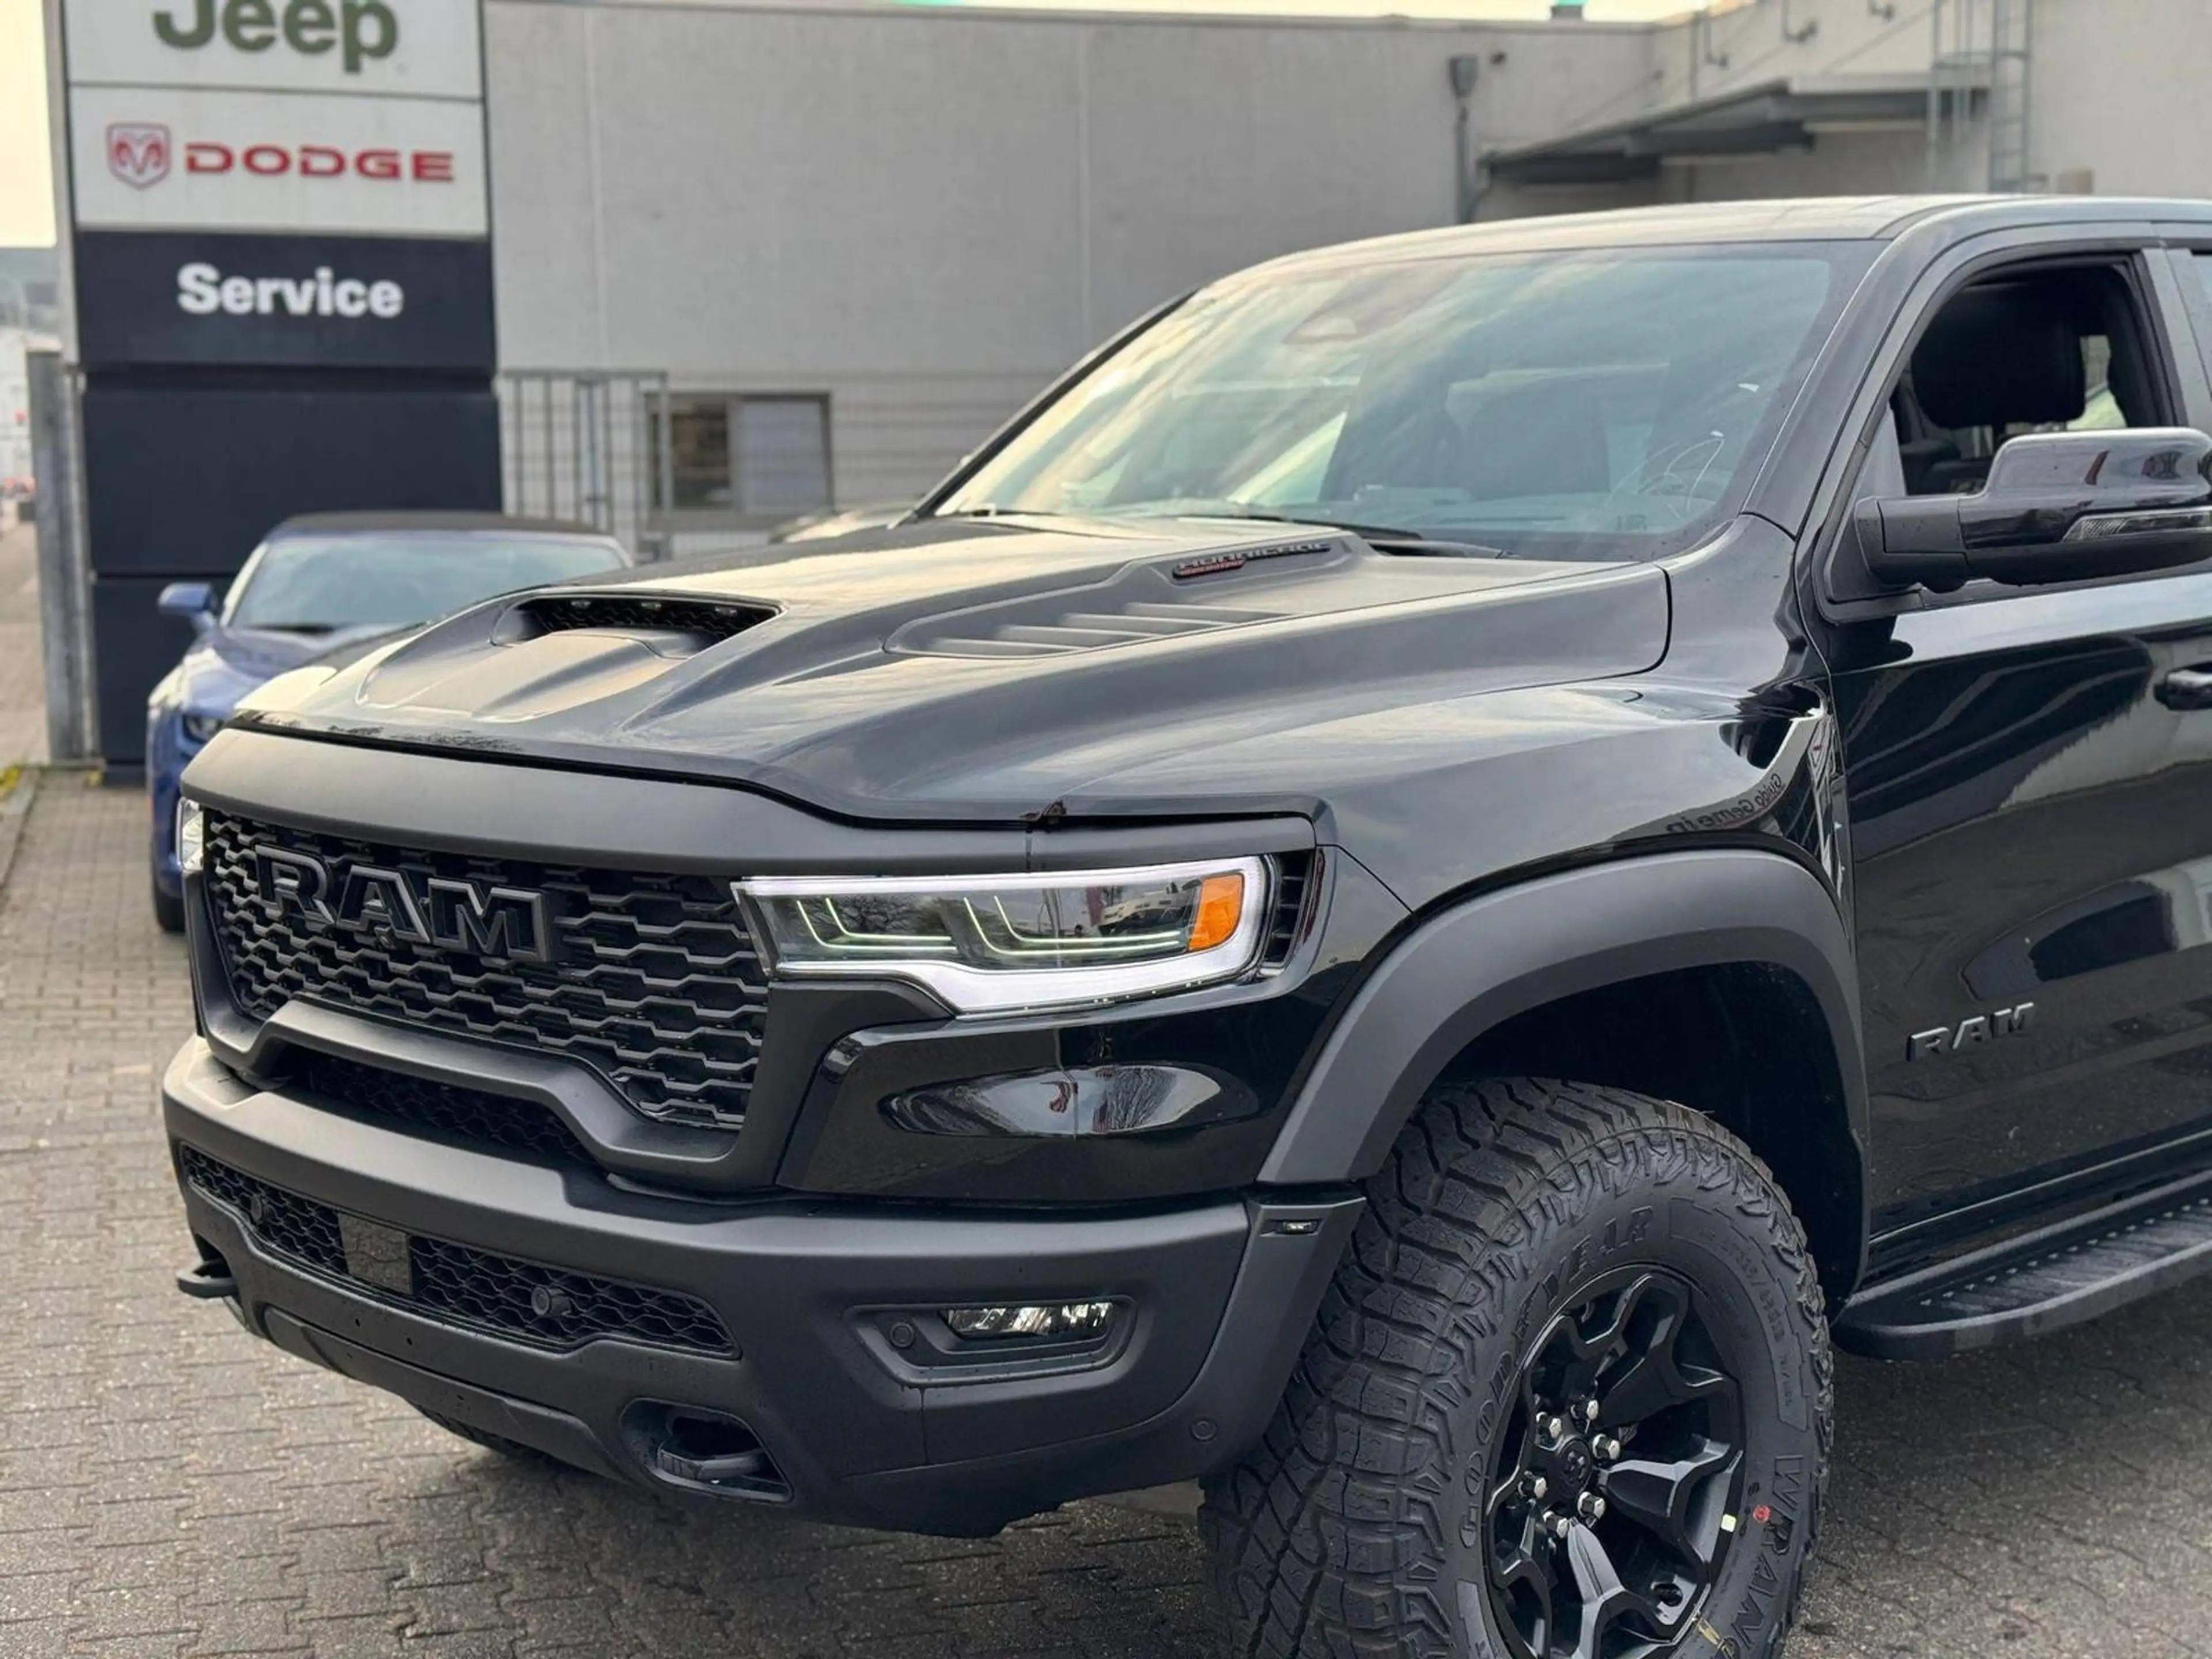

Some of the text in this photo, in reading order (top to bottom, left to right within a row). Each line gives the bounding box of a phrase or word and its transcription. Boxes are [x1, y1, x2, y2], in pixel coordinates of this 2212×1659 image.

[153, 0, 397, 74] Jeep
[184, 143, 455, 182] DODGE
[176, 263, 404, 317] Service
[255, 843, 551, 963] RAM
[1906, 1001, 2035, 1062] RAM
